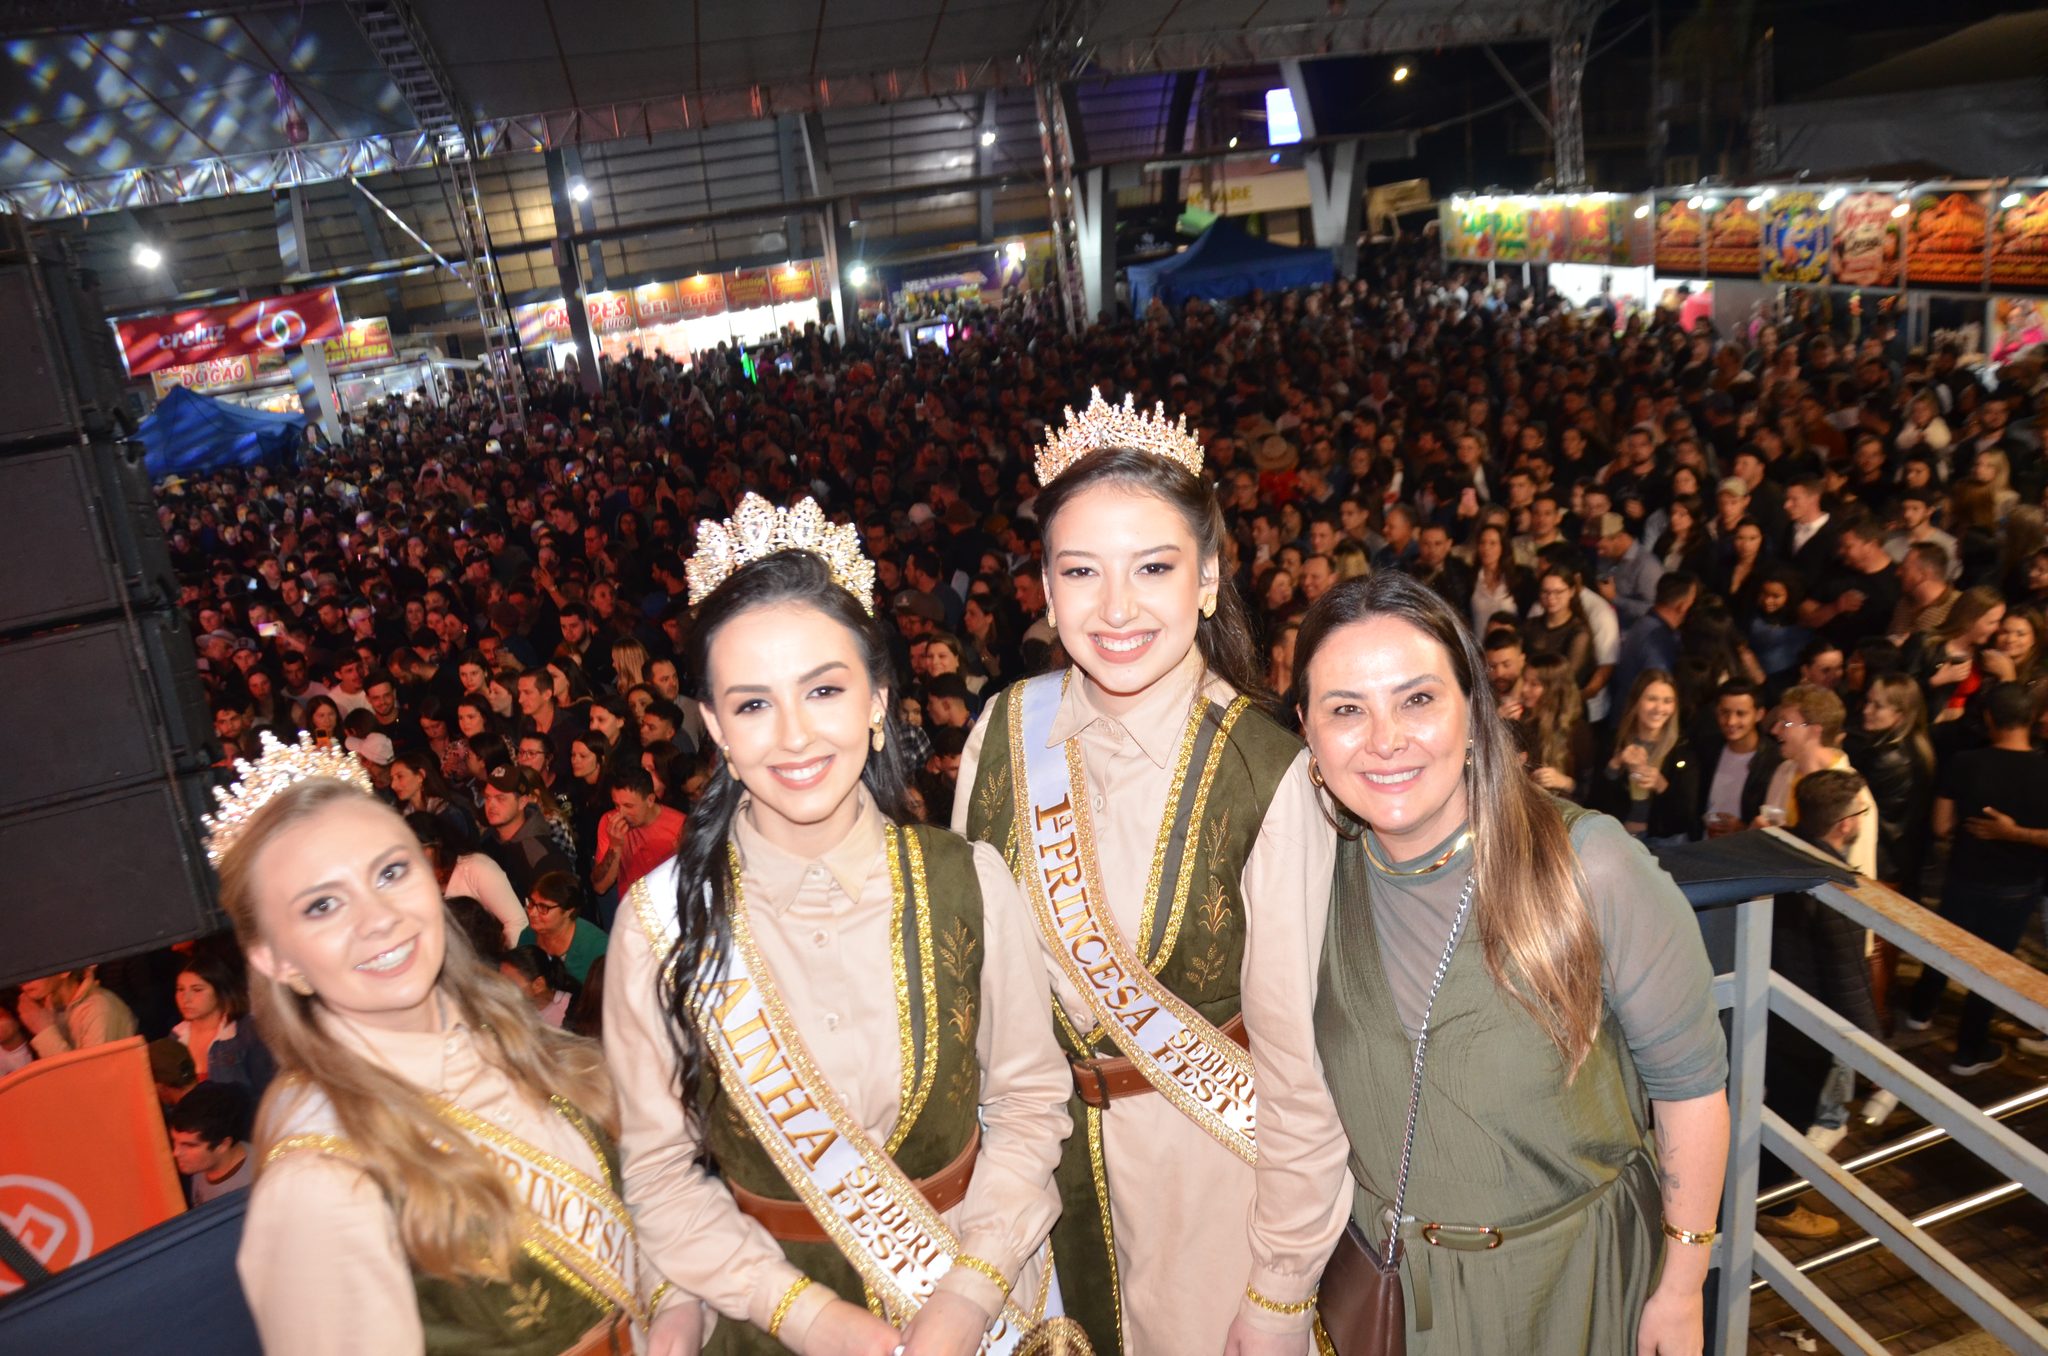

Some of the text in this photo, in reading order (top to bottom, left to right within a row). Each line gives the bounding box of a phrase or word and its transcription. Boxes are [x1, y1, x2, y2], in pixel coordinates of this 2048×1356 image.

[158, 322, 226, 350] creluz
[543, 294, 627, 328] CRPES
[639, 299, 670, 317] REI
[682, 290, 724, 308] CREPE
[1039, 835, 1162, 1037] PRINCESA
[697, 946, 839, 1172] AINHA
[1149, 1041, 1239, 1116] FEST
[1168, 1028, 1256, 1107] SEBERI
[825, 1178, 916, 1278] FEST
[843, 1165, 941, 1269] SEBERI
